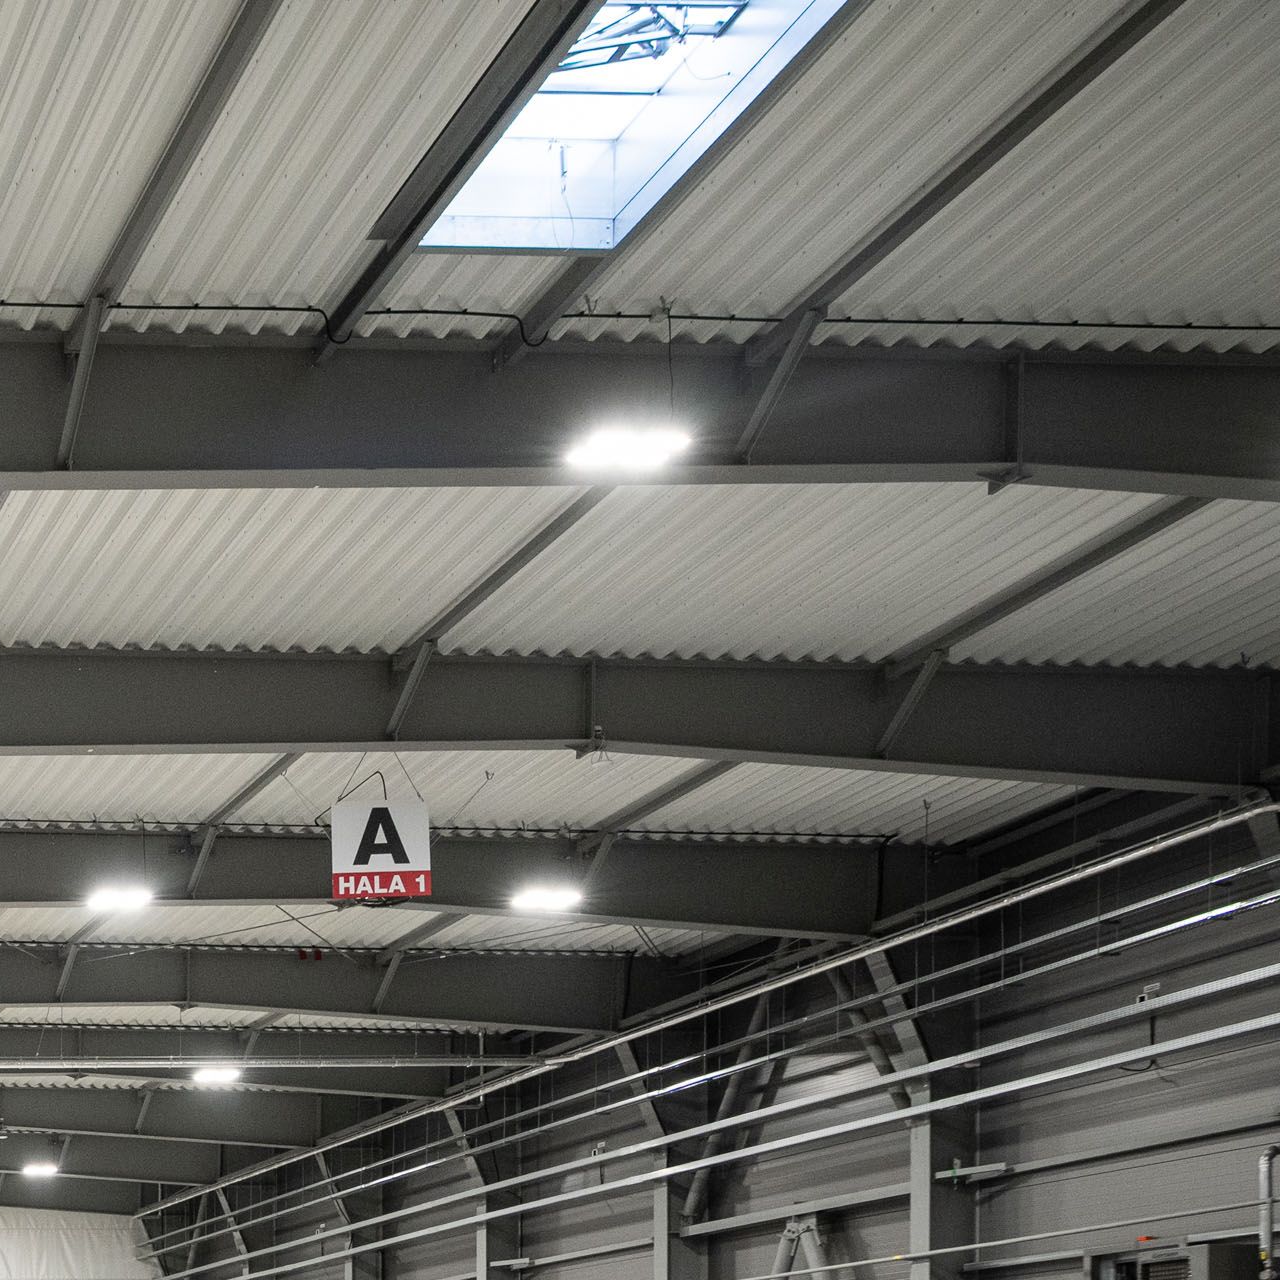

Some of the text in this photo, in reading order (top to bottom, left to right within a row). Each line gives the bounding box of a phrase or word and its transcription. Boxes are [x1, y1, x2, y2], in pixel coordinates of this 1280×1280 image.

[353, 808, 410, 865] A
[338, 873, 426, 895] HALA 1
